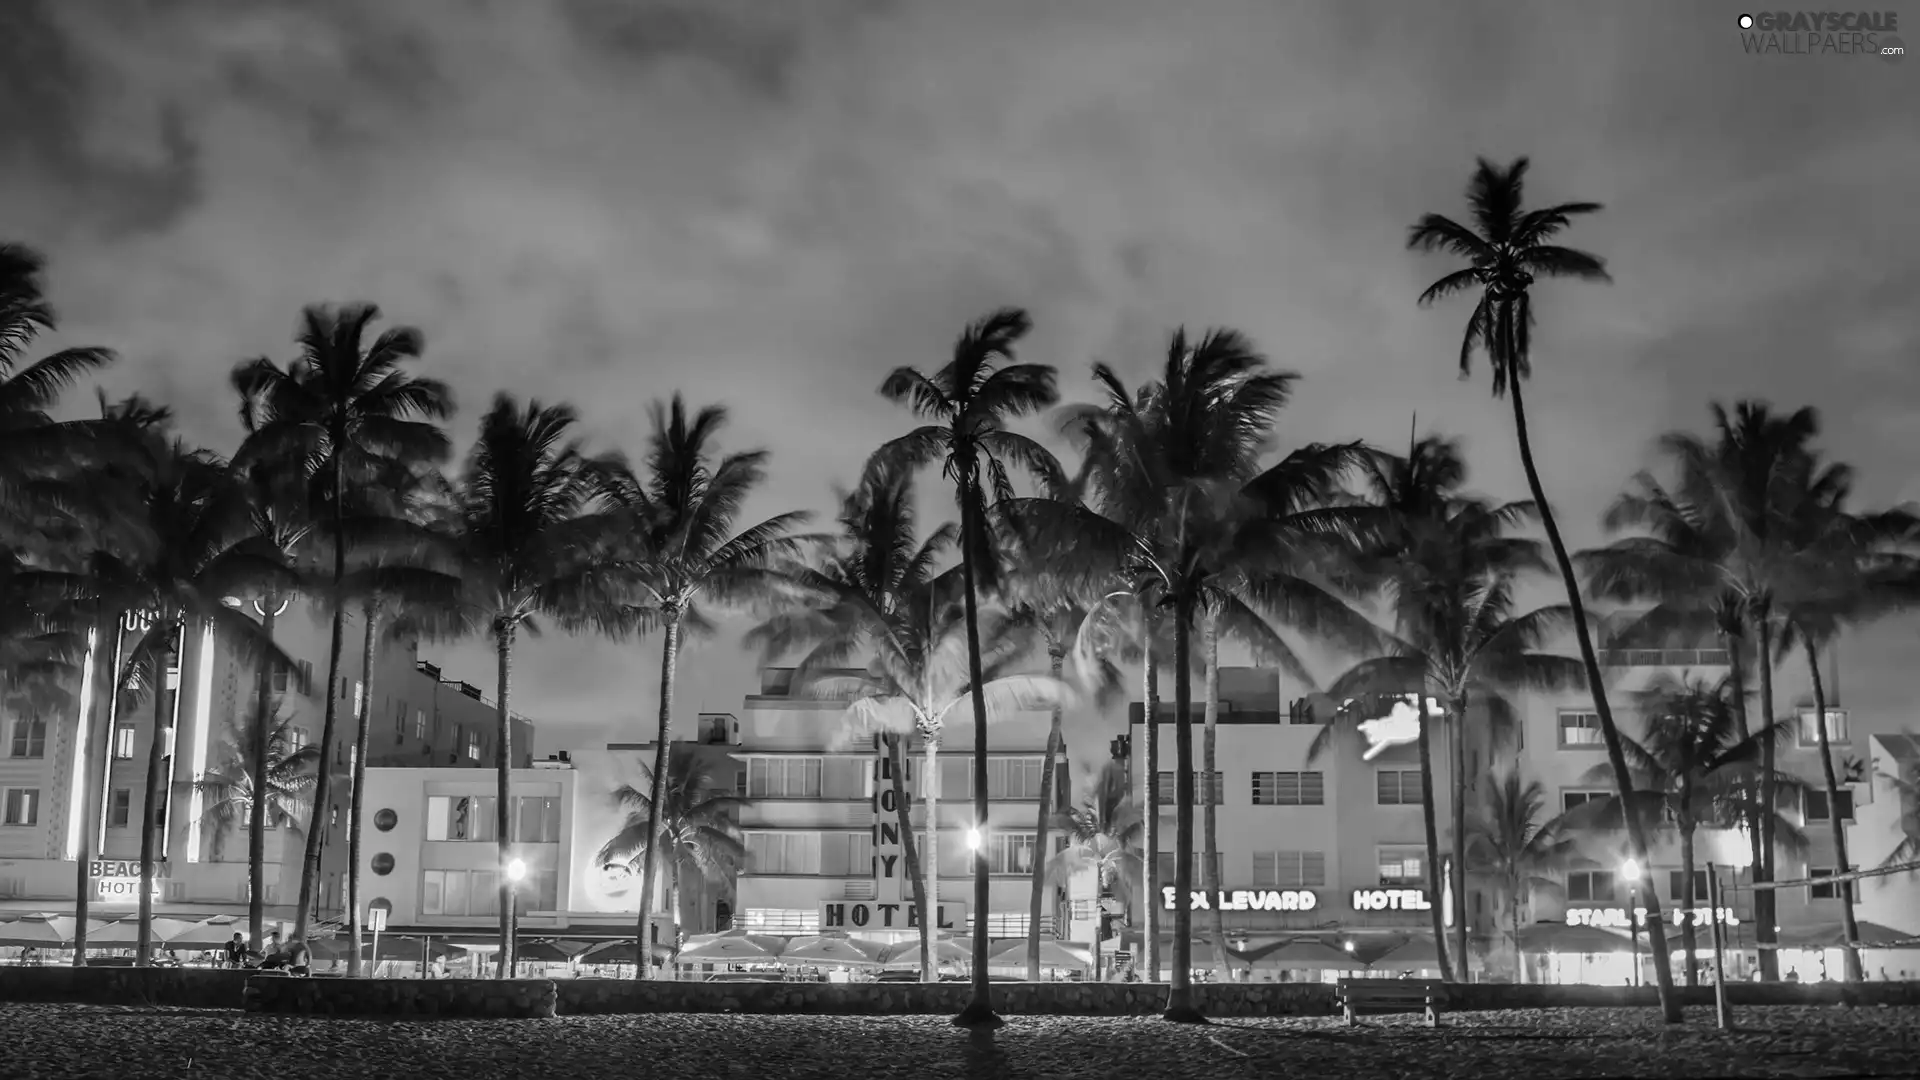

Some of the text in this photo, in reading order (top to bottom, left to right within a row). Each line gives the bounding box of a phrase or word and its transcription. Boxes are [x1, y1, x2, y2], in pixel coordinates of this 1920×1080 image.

[100, 881, 159, 893] HOT
[1353, 890, 1432, 910] HOTEL
[826, 904, 953, 928] HOTEL
